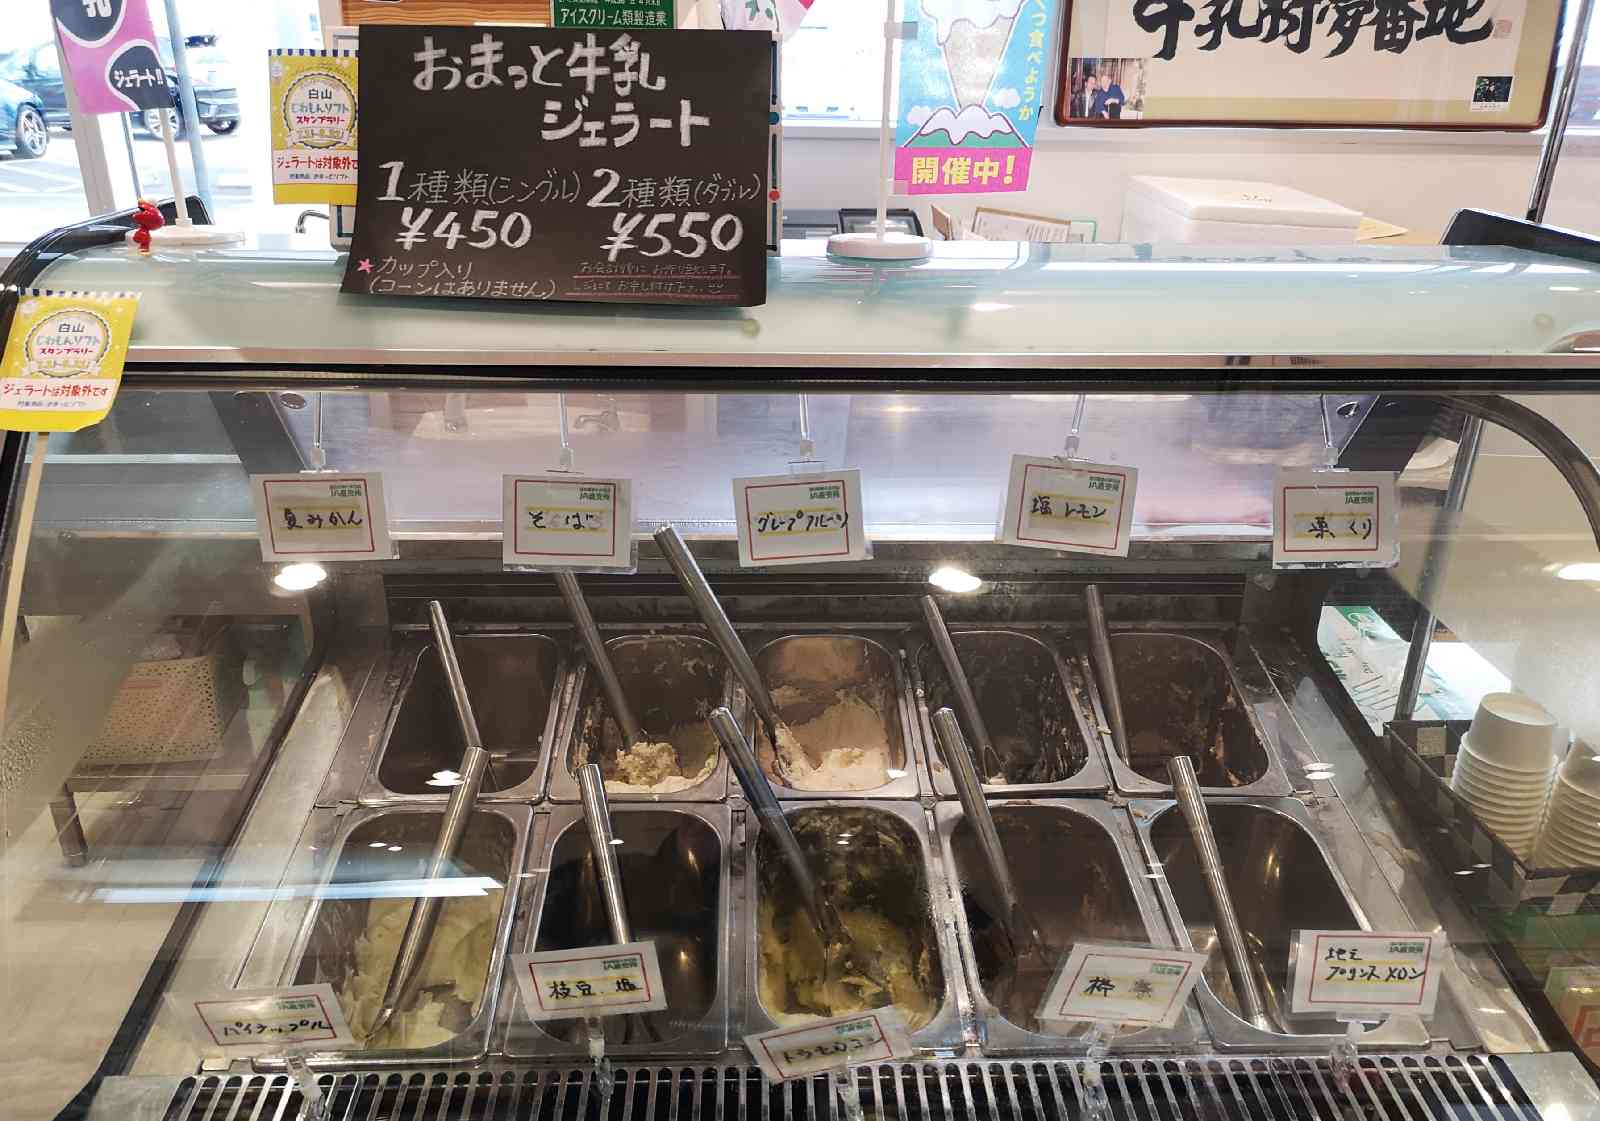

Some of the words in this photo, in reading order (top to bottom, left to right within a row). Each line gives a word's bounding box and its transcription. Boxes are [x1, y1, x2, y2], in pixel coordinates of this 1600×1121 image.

[560, 8, 668, 26] アイスクリーム類製造業
[413, 33, 666, 96] おまっと牛乳
[308, 88, 332, 99] 白山
[296, 115, 345, 125] スタンプラリー
[541, 95, 710, 148] ジェラート
[911, 155, 1016, 185] 開催中!
[395, 207, 532, 250] ¥450
[600, 211, 743, 262] ¥550
[377, 256, 472, 279] カップ入り
[58, 323, 85, 333] 白山
[284, 508, 363, 530] 夏みかん
